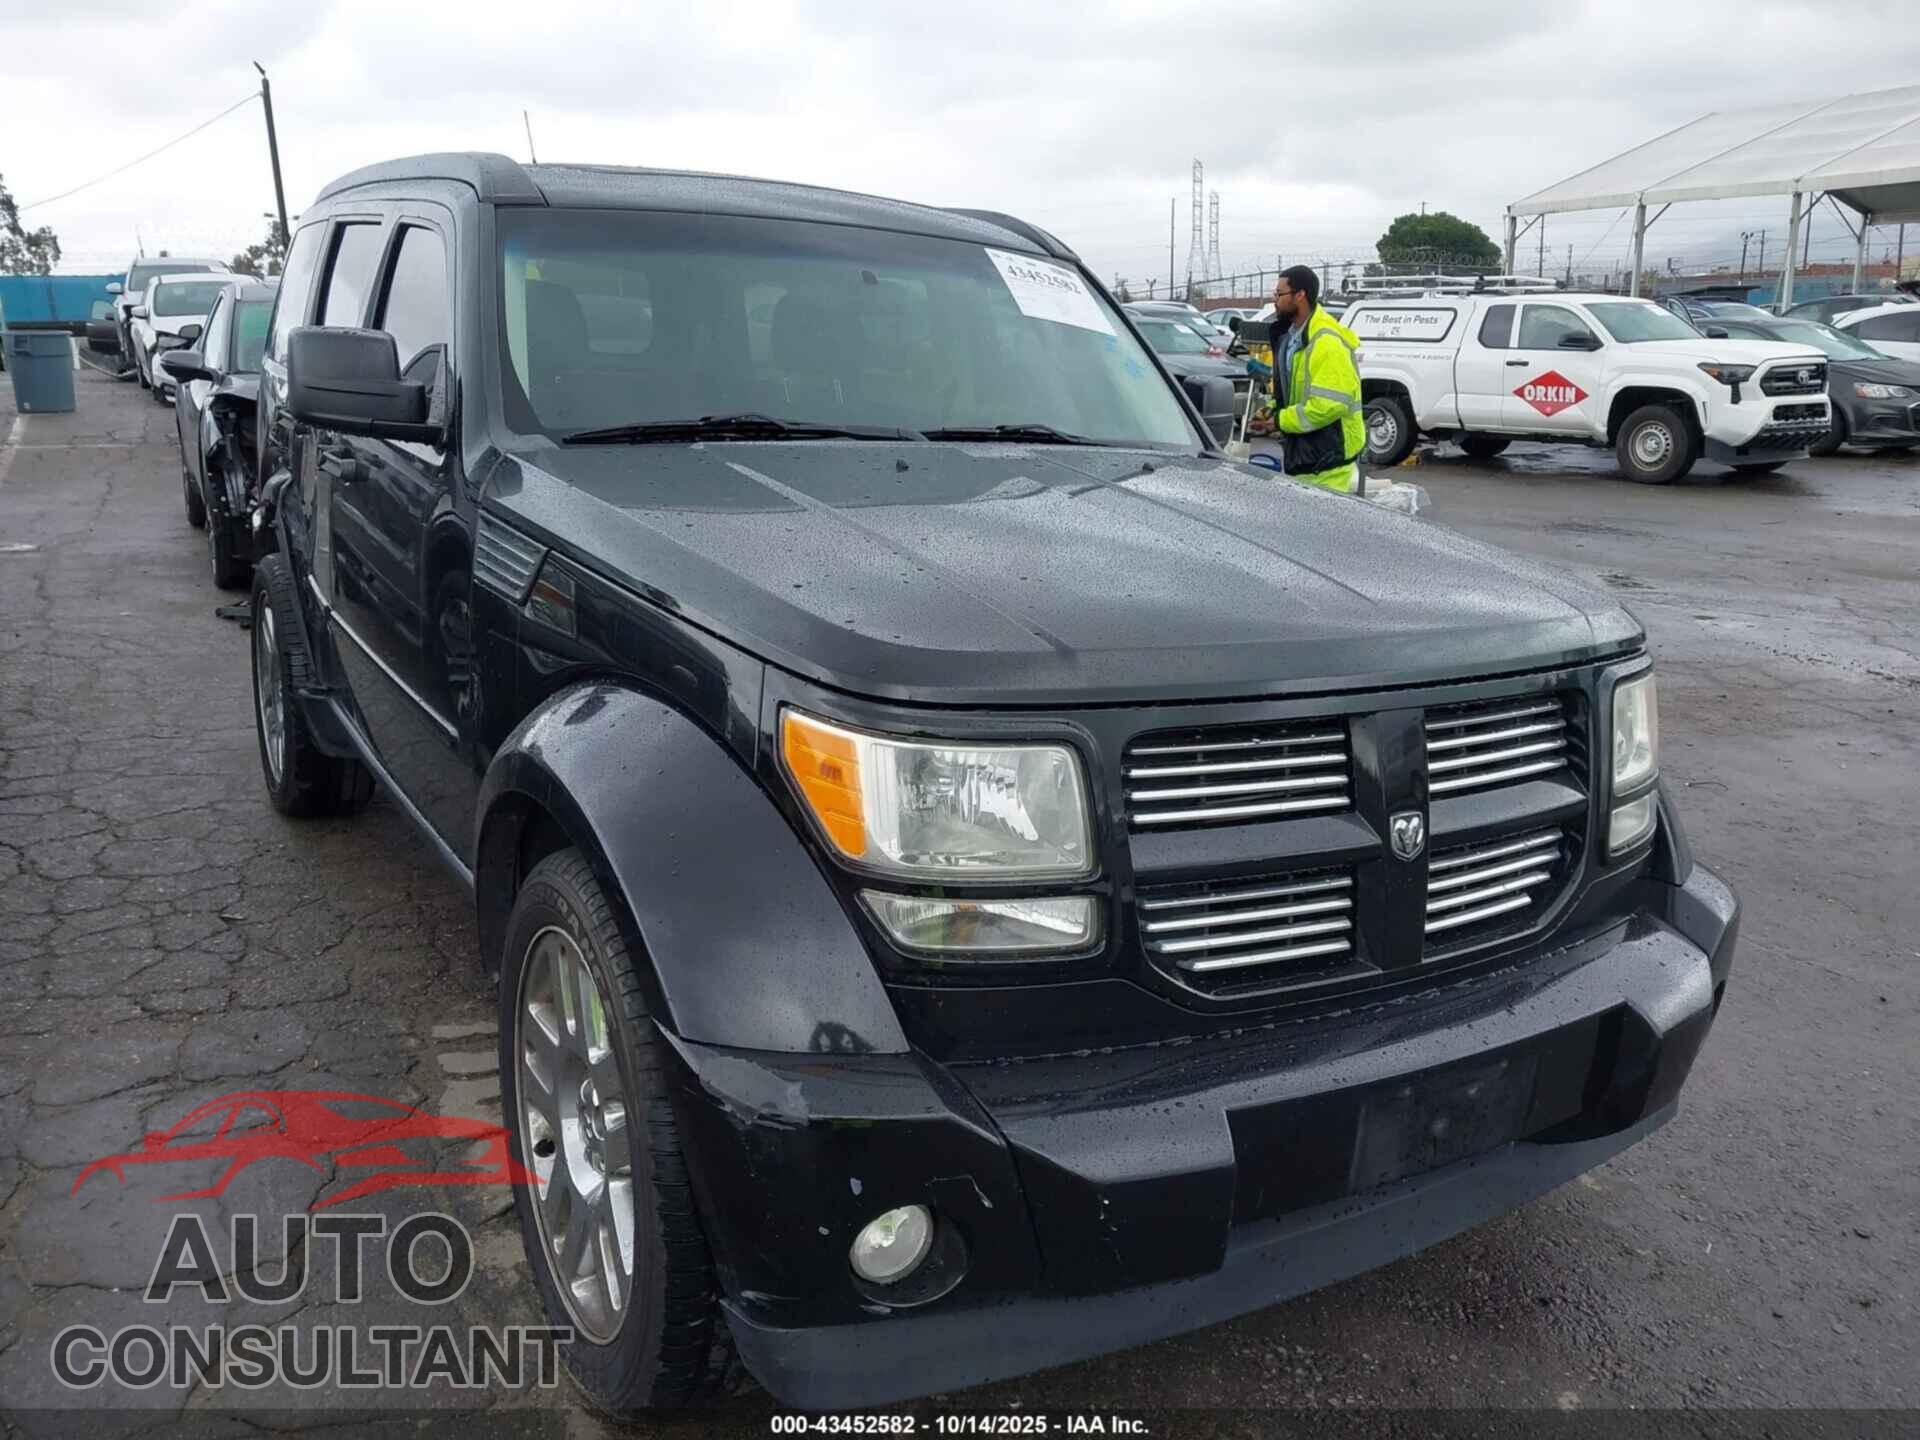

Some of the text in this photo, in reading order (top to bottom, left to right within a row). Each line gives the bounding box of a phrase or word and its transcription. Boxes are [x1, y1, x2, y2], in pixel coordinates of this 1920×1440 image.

[1365, 314, 1438, 325] The Best in Pests
[1524, 385, 1575, 402] ORKIN
